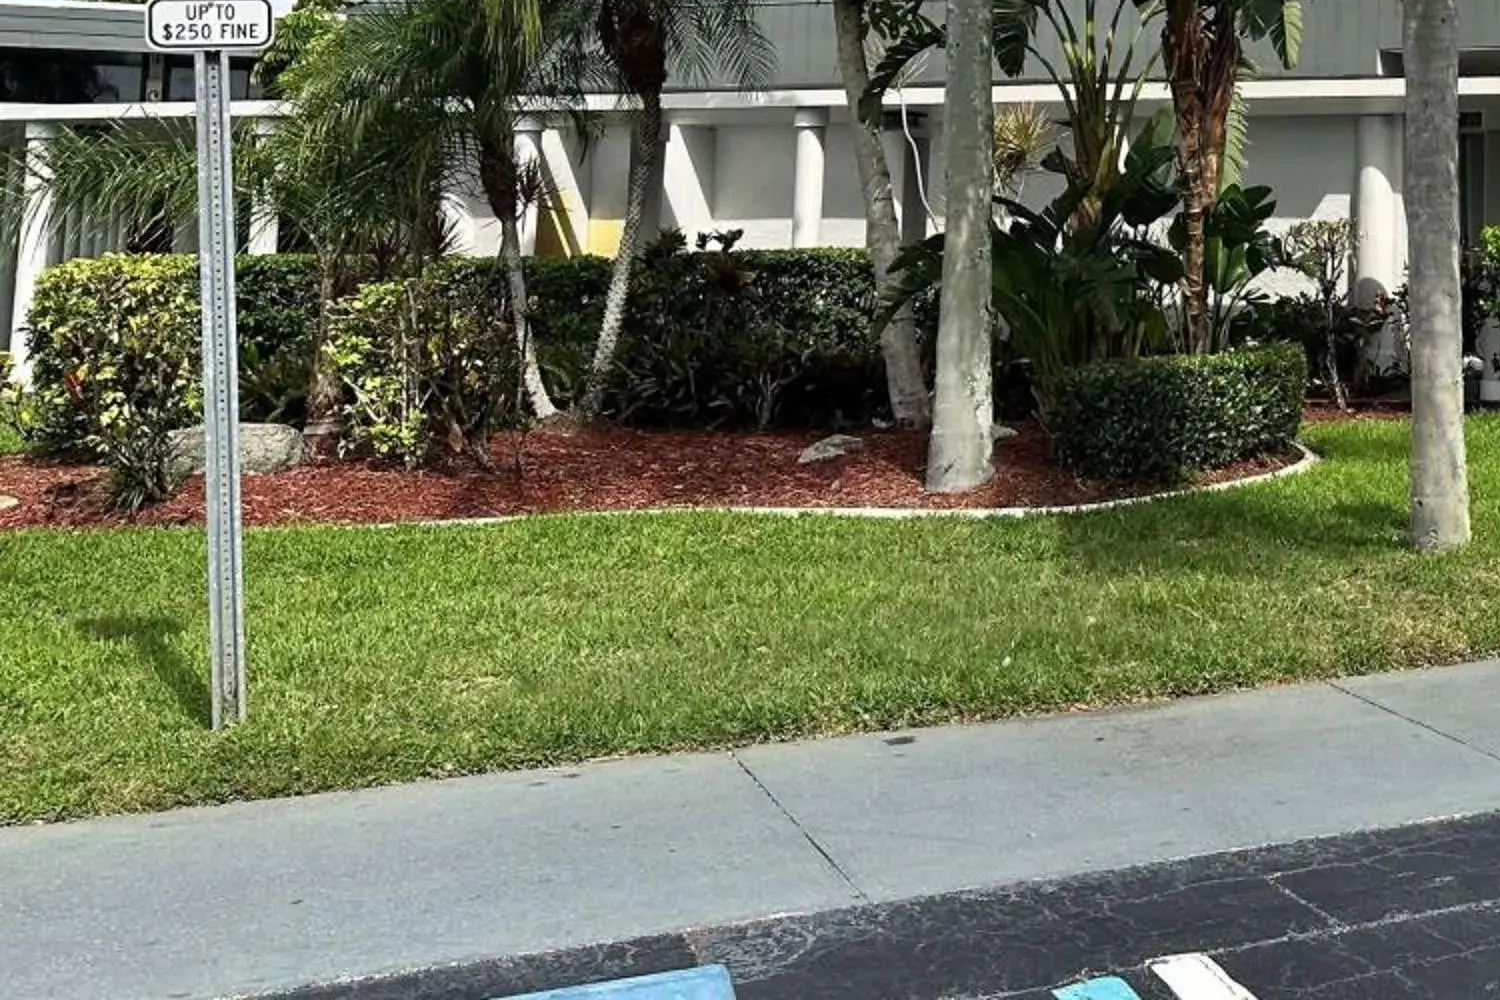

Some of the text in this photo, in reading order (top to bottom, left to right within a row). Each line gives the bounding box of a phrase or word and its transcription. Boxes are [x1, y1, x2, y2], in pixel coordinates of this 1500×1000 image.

[185, 3, 235, 21] UP TO
[162, 22, 259, 40] $250 FINE
